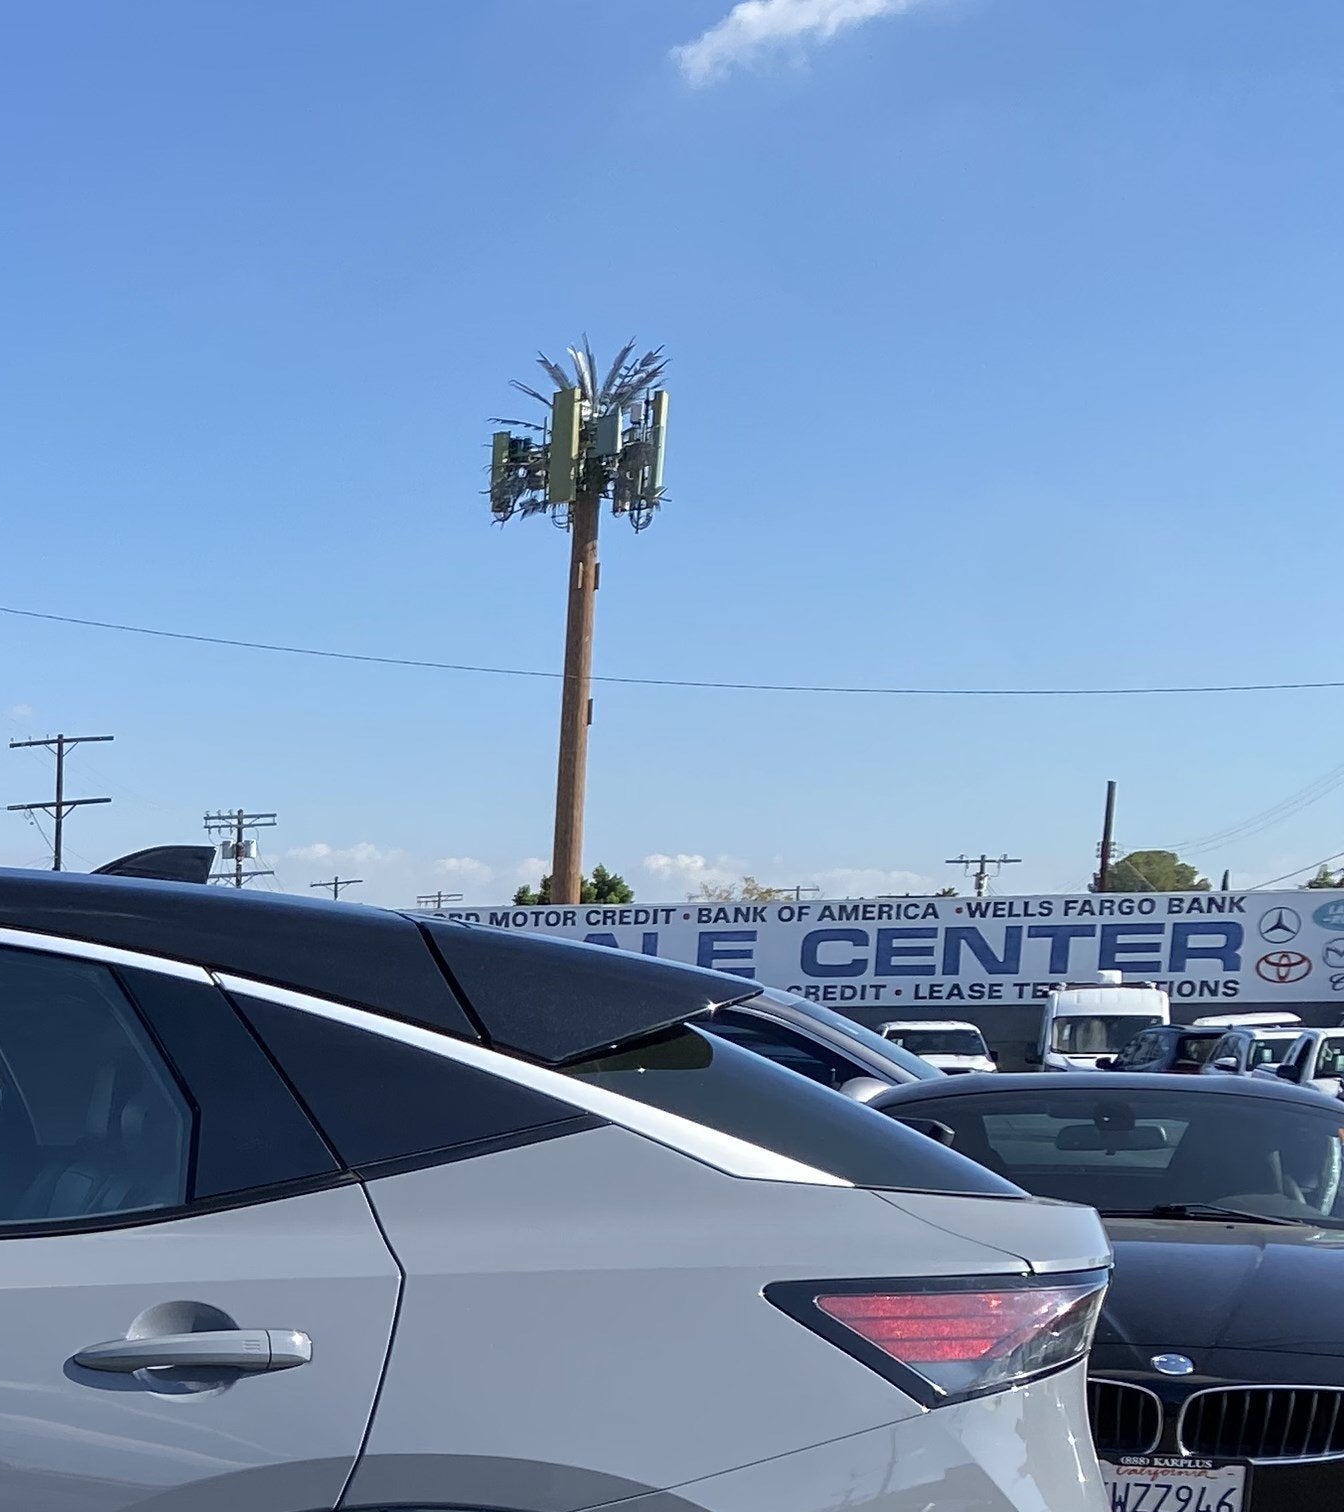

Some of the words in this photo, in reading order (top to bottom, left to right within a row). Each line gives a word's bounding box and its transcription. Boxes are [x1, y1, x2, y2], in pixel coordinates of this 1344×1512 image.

[488, 910, 577, 929] MOTOR
[585, 908, 676, 926] CREDIT
[697, 906, 767, 924] BANK
[777, 905, 810, 923] OF
[817, 902, 940, 923] AMERICA
[966, 901, 1053, 919] WELLS
[1064, 897, 1161, 917] FARGO
[1166, 896, 1247, 915] BANK
[800, 921, 1245, 978] CENTER
[914, 982, 1003, 1000] LEASE
[1120, 1456, 1150, 1465] (888)
[1153, 1457, 1213, 1468] KARPLUS
